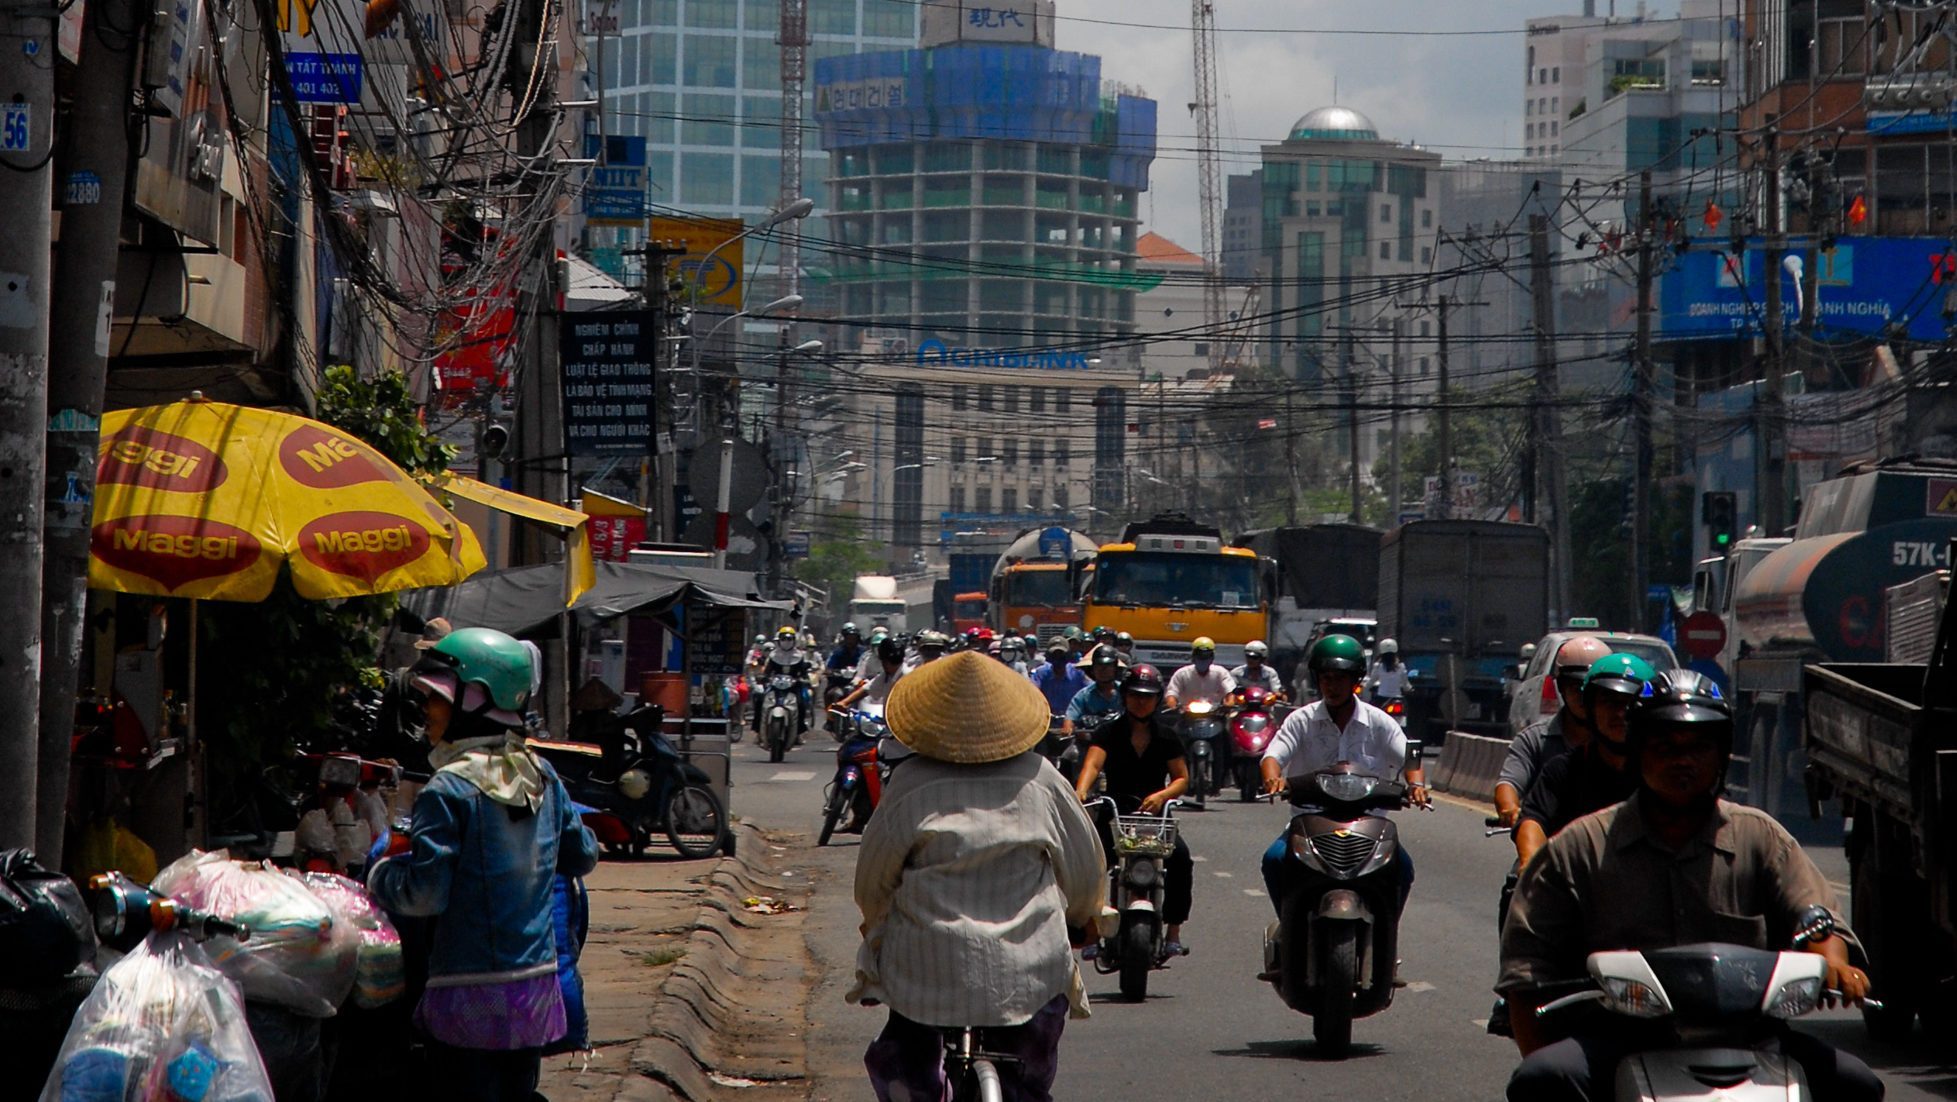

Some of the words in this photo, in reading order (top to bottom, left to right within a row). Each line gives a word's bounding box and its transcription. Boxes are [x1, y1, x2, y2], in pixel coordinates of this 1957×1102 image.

[969, 7, 1024, 28] 現代
[576, 322, 609, 336] NGHIÊM
[583, 341, 606, 356] CHẤP
[566, 362, 586, 378] LUẬT
[588, 361, 599, 379] LỆ
[600, 363, 621, 377] GIAO
[624, 361, 651, 376] THÔNG
[577, 381, 594, 398] BẢO
[595, 382, 608, 400] VỆ
[605, 404, 622, 417] CHO
[579, 424, 597, 437] CHO
[627, 421, 650, 437] KHÁC
[113, 527, 238, 561] Maggi
[313, 524, 412, 555] Maggi
[1151, 651, 1193, 661] DAEWO
